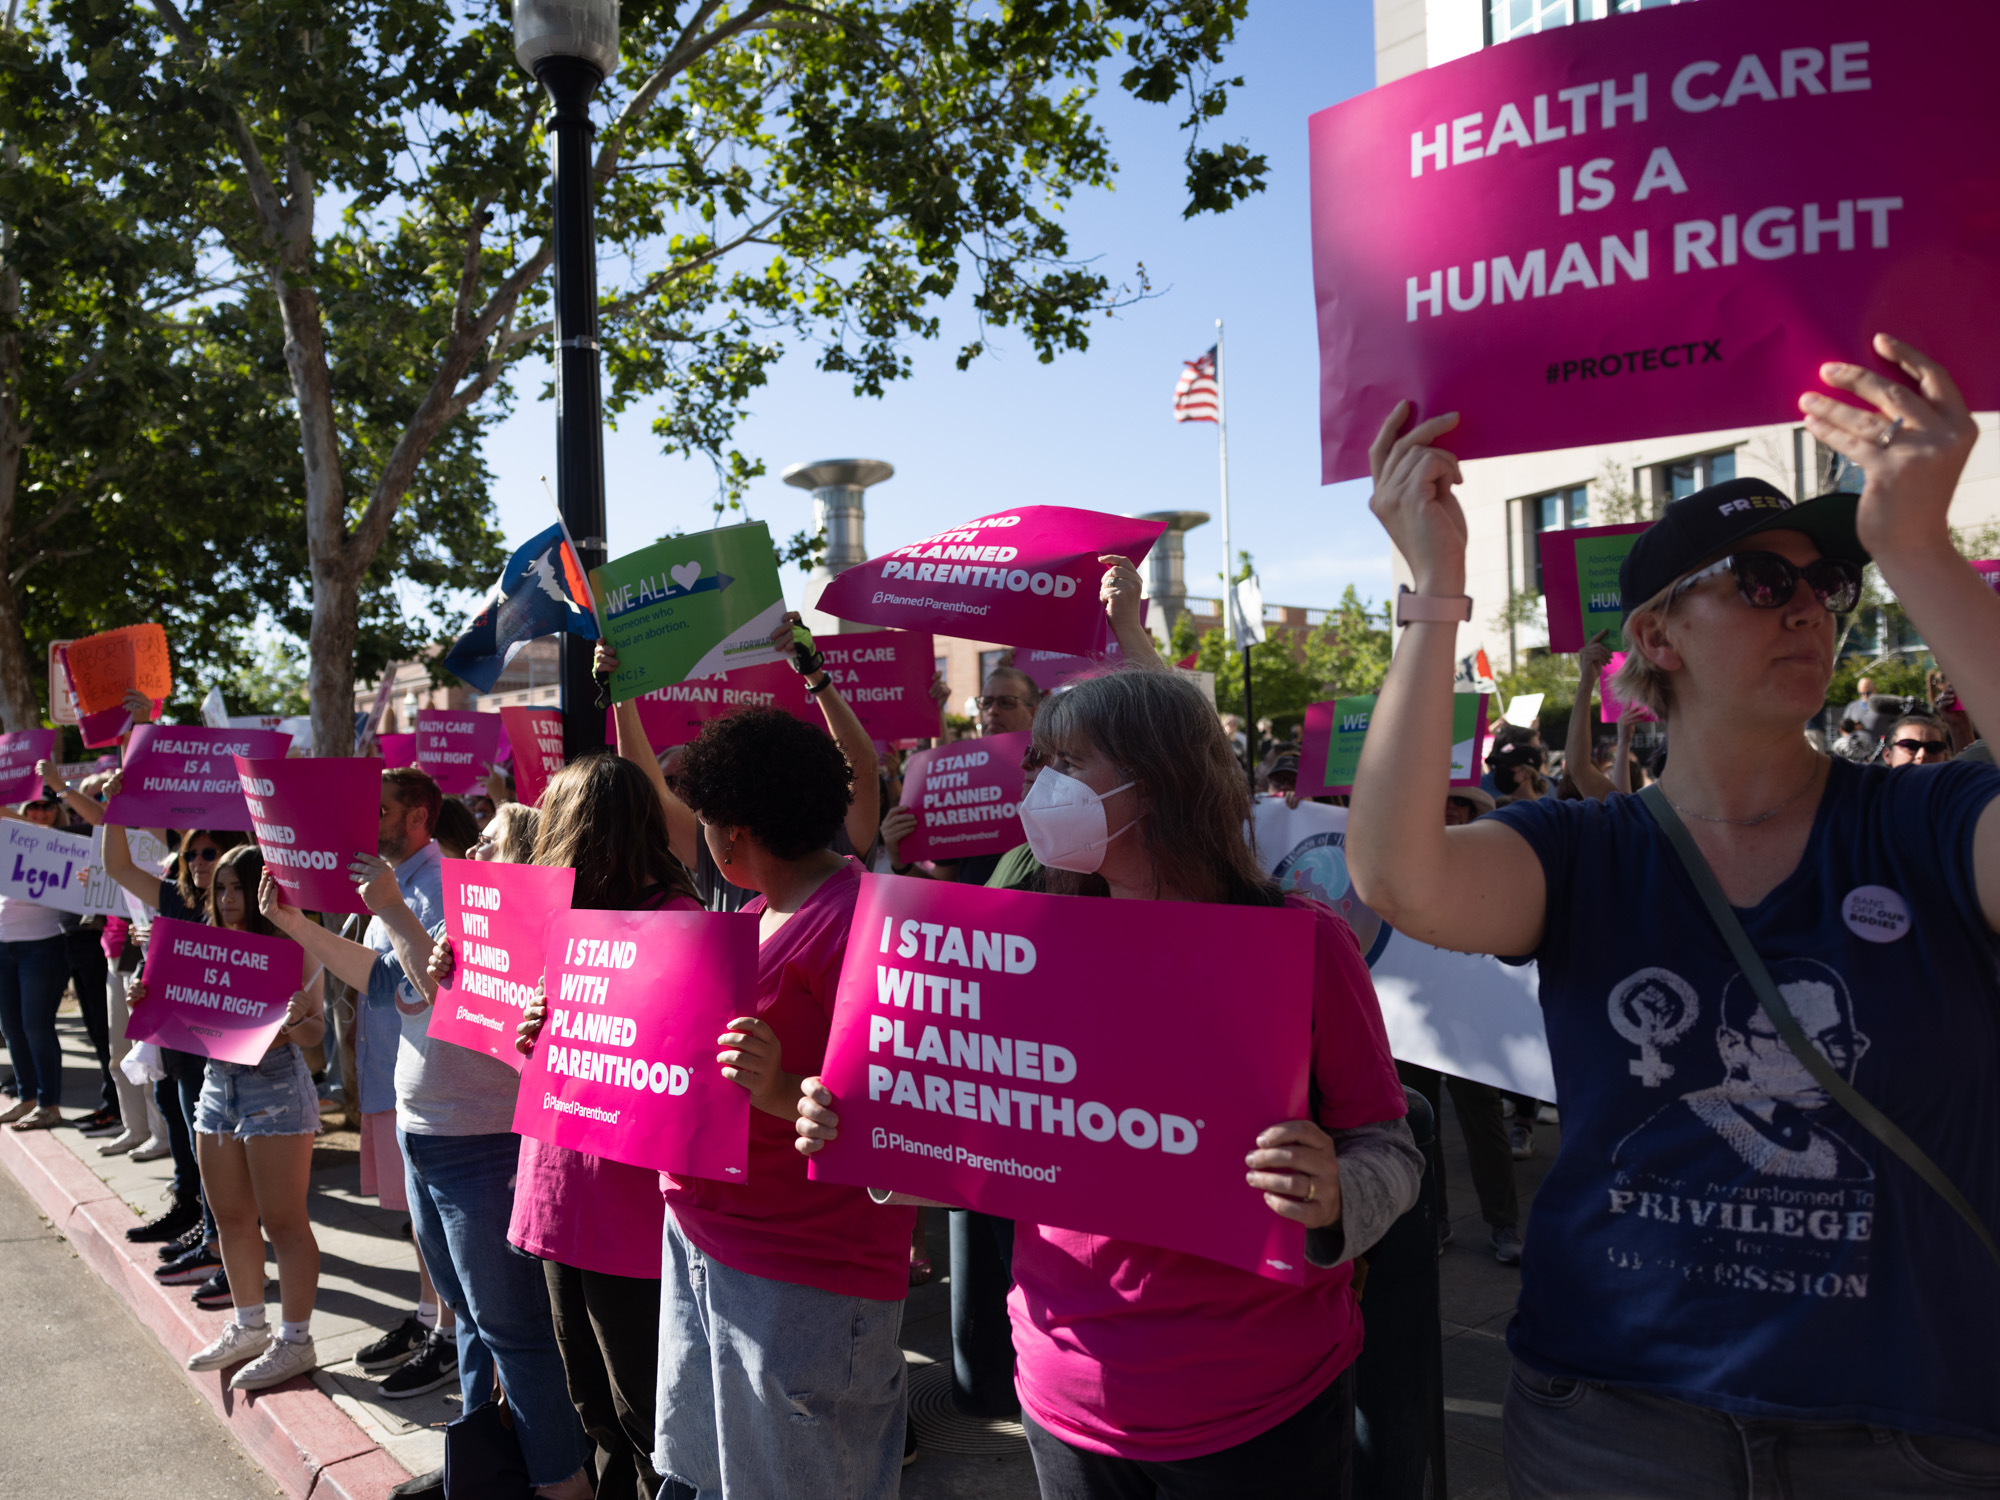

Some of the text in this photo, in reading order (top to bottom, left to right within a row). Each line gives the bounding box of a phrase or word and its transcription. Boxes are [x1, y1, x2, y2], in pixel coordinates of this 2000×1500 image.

[1411, 41, 1872, 179] HEALTH CARE
[1558, 146, 1688, 216] IS A
[1406, 196, 1903, 323] HUMAN RIGHT
[1545, 339, 1722, 384] #PROTECTX
[892, 546, 1018, 563] PLANNED
[881, 561, 1077, 598] PARENTHOOD
[606, 572, 676, 614] WE ALL
[883, 593, 986, 615] Planned Parenthood
[1591, 592, 1621, 608] HUM
[612, 607, 674, 634] someone who
[615, 620, 690, 649] had an abortion.
[852, 647, 896, 664] CARE
[846, 668, 860, 683] A
[644, 686, 718, 702] HUMAN
[722, 688, 775, 706] RIGHT
[856, 686, 904, 702] RIGHT
[445, 721, 475, 734] CARE
[532, 720, 539, 734] I
[1343, 712, 1368, 731] WE
[11, 741, 30, 753] CARE
[151, 739, 251, 757] HEALTH CARE
[430, 736, 447, 748] IS A
[184, 760, 211, 774] IS A
[443, 753, 474, 765] RIGHT
[927, 751, 990, 774] I STAND
[9, 766, 31, 779] RIGHT
[926, 771, 969, 791] WITH
[143, 777, 243, 794] HUMAN RIGHT
[923, 785, 1002, 809] PLANNED
[245, 795, 266, 819] ITH
[924, 801, 1022, 828] PARENTHO
[9, 828, 39, 853] Keep
[252, 820, 296, 844] ANNED
[260, 845, 338, 870] RENTHOOD
[11, 853, 73, 899] Legal
[460, 884, 500, 911] I STAND
[1853, 896, 1885, 909] BANS
[461, 912, 489, 939] WITH
[1850, 913, 1896, 930] BODIES
[1877, 910, 1905, 923] OUR
[173, 939, 269, 971] HEALTH CARE
[462, 941, 509, 973] PLANNED
[564, 938, 637, 969] I STAND
[879, 916, 1037, 975] I STAND
[203, 967, 231, 988] IS A
[560, 973, 609, 1005] WITH
[165, 984, 268, 1018] HUMAN RIGHT
[876, 965, 981, 1021] WITH
[462, 1008, 503, 1033] Planned Parenthood
[550, 1008, 637, 1047] PLANNED
[869, 1014, 1077, 1085] PLANNED
[546, 1045, 690, 1096] PARENTHOOD
[549, 1096, 618, 1125] Planned Parenthood
[868, 1064, 1199, 1155] PARENTHOOD
[889, 1133, 1056, 1183] Planned Parenthood
[1608, 1187, 1874, 1242] PRIVILEGE
